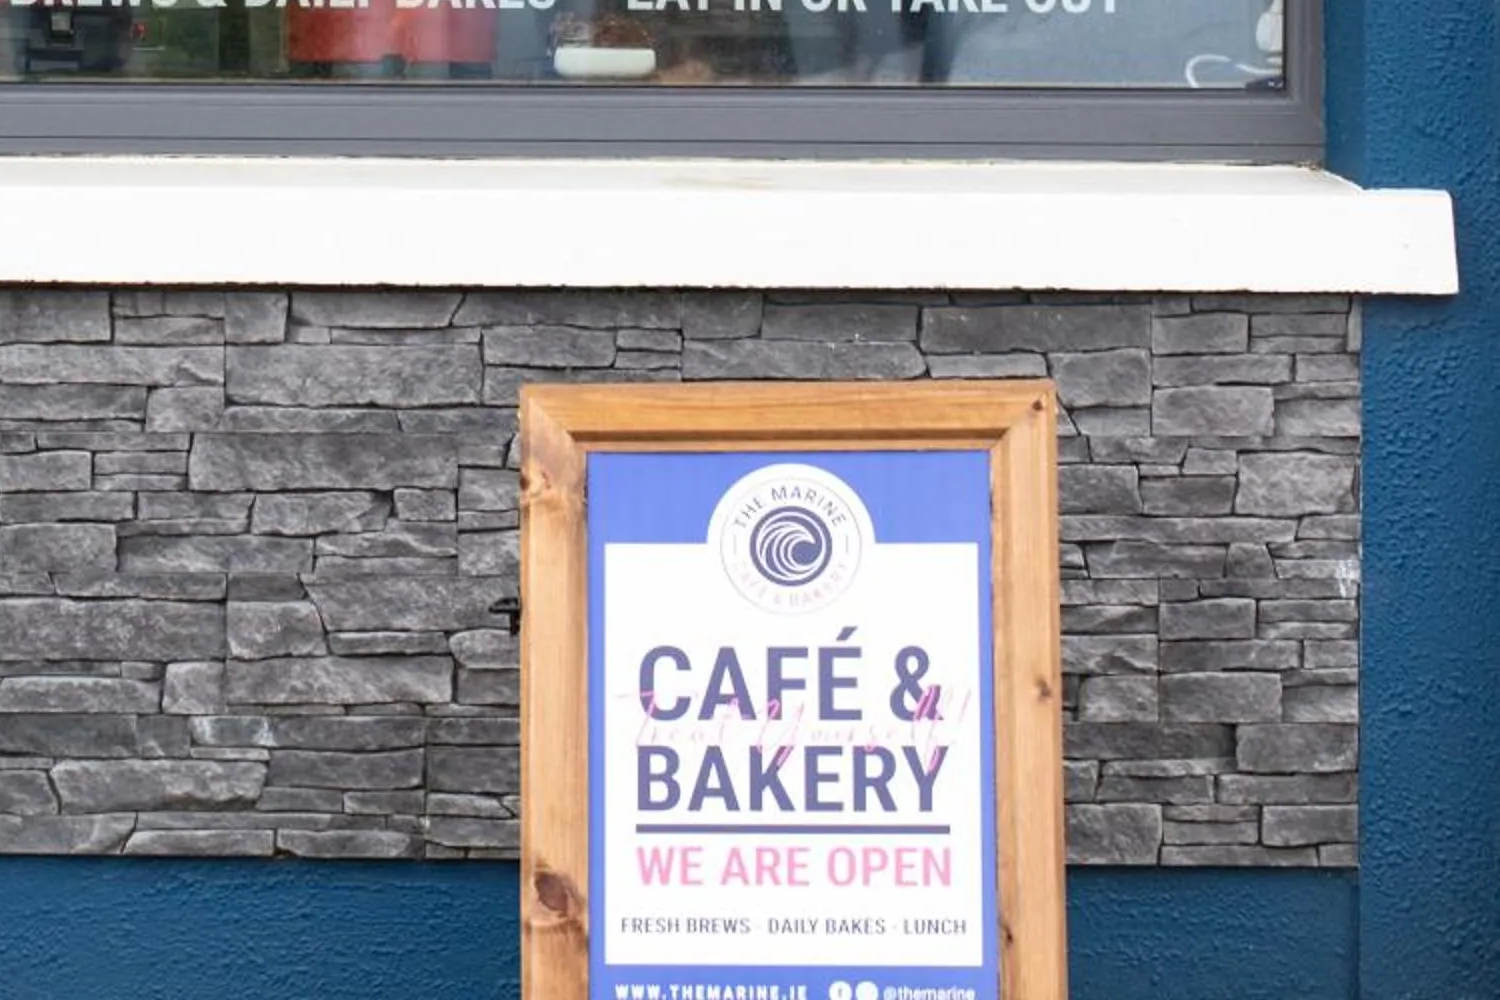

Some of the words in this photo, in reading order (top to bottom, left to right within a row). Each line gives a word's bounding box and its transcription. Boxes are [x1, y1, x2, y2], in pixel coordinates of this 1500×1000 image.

[733, 496, 765, 528] THE
[771, 485, 848, 528] MARINE
[638, 626, 863, 721] CAFÉ
[888, 645, 945, 722] &
[636, 745, 949, 812] BAKERY
[636, 846, 704, 886] WE
[719, 846, 811, 886] ARE
[827, 846, 952, 888] OPEN
[620, 917, 680, 934] FRESH
[687, 917, 751, 934] BREWS
[768, 918, 818, 935] DAILY
[825, 918, 886, 935] BAKES
[903, 918, 967, 935] LUNCH
[615, 983, 807, 1000] WWW.THEMARINE.IE
